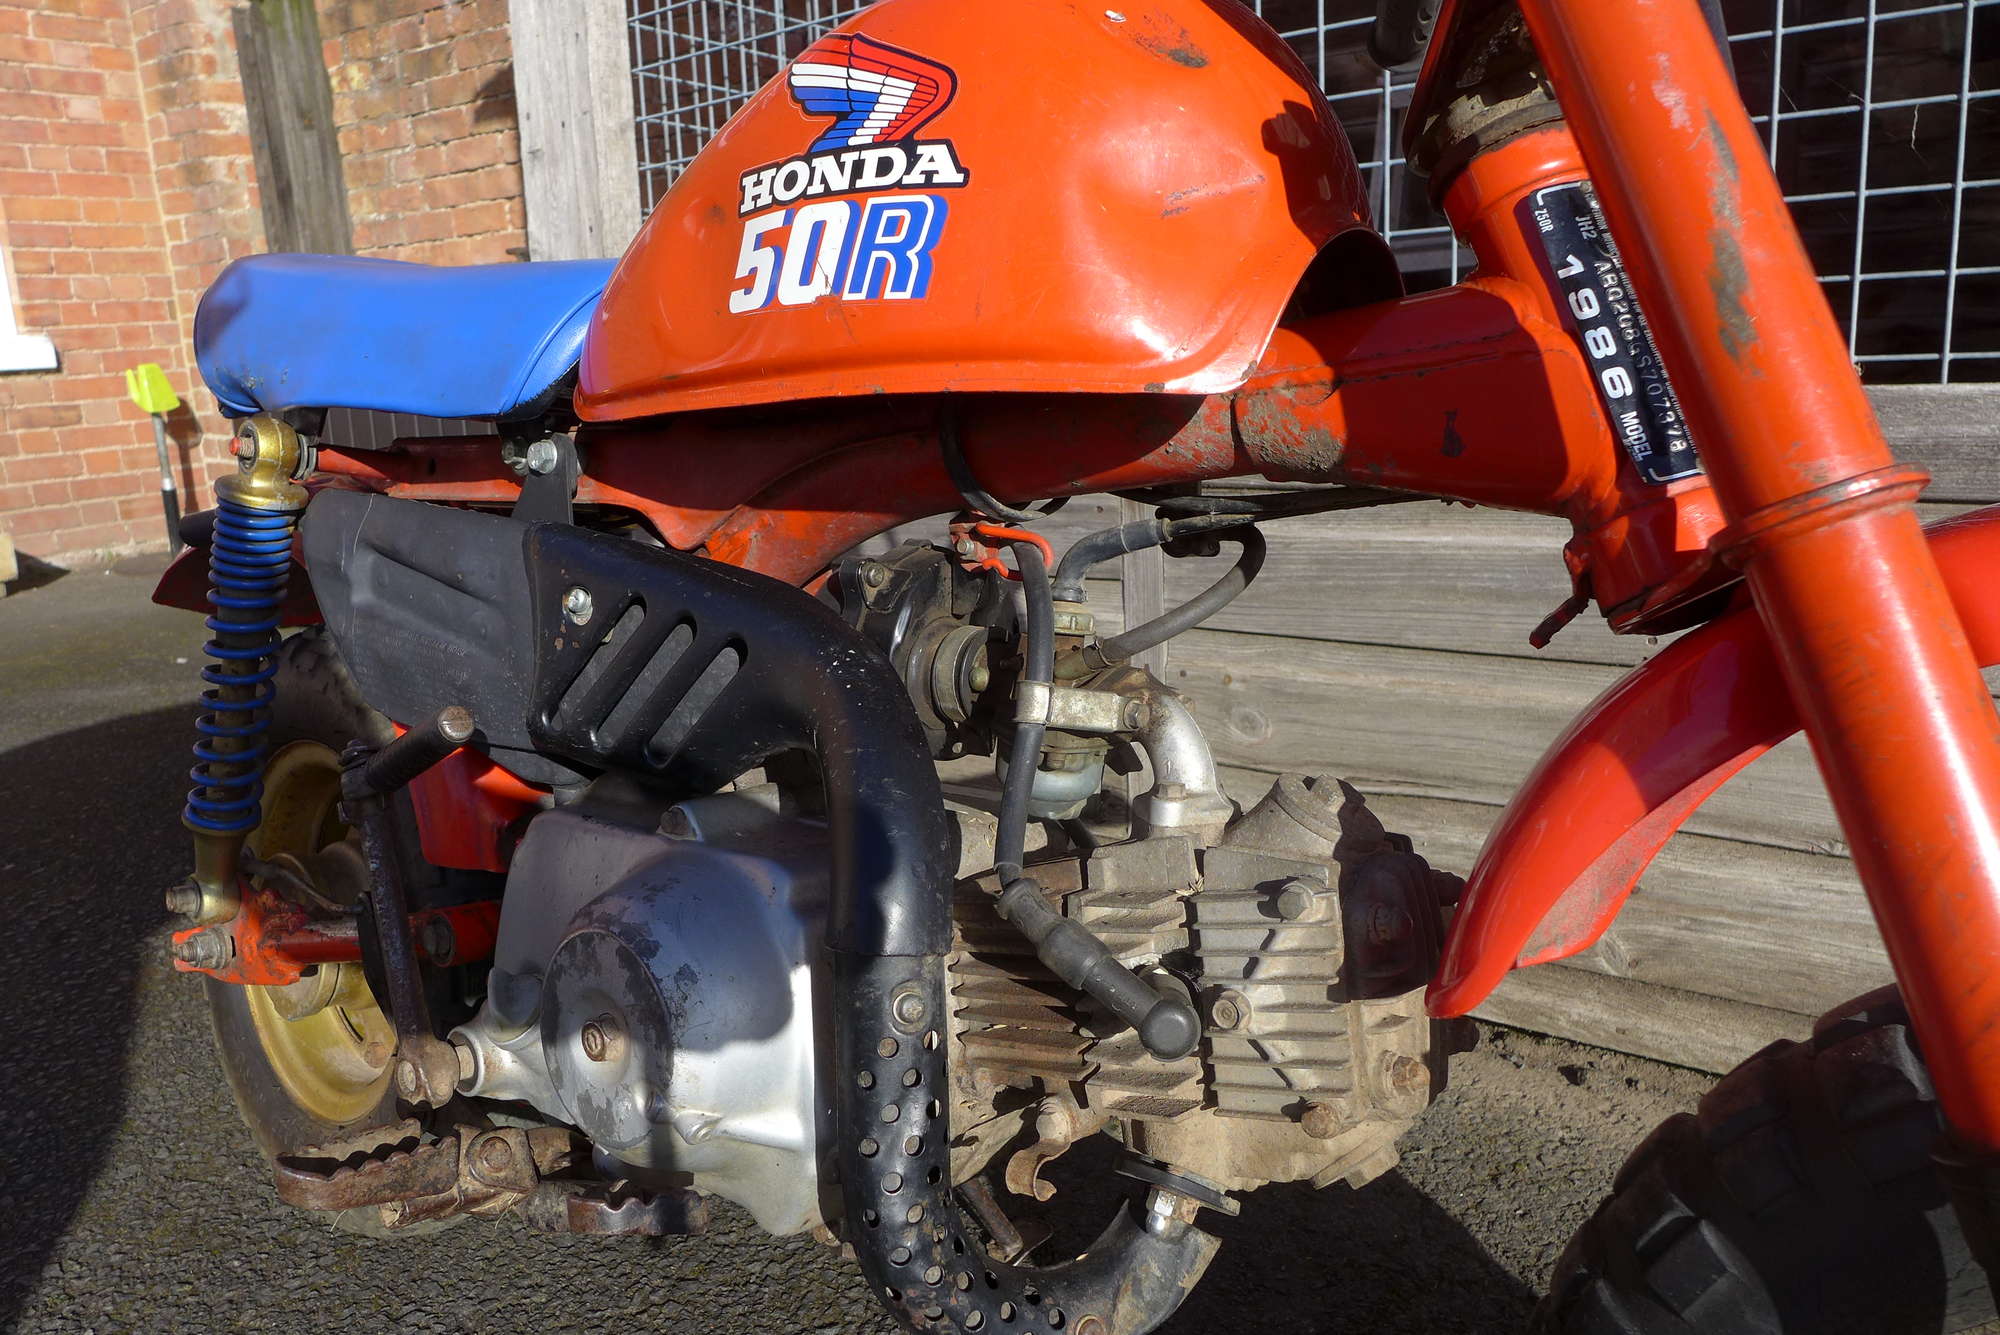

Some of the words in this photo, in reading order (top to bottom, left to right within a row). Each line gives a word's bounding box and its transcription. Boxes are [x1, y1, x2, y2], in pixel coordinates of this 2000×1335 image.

[740, 143, 965, 214] HONDA
[729, 194, 948, 313] 50R
[1575, 216, 1598, 240] JH2
[1535, 208, 1554, 233] Z50R
[1557, 254, 1633, 399] 1986
[1620, 411, 1652, 462] MODEL
